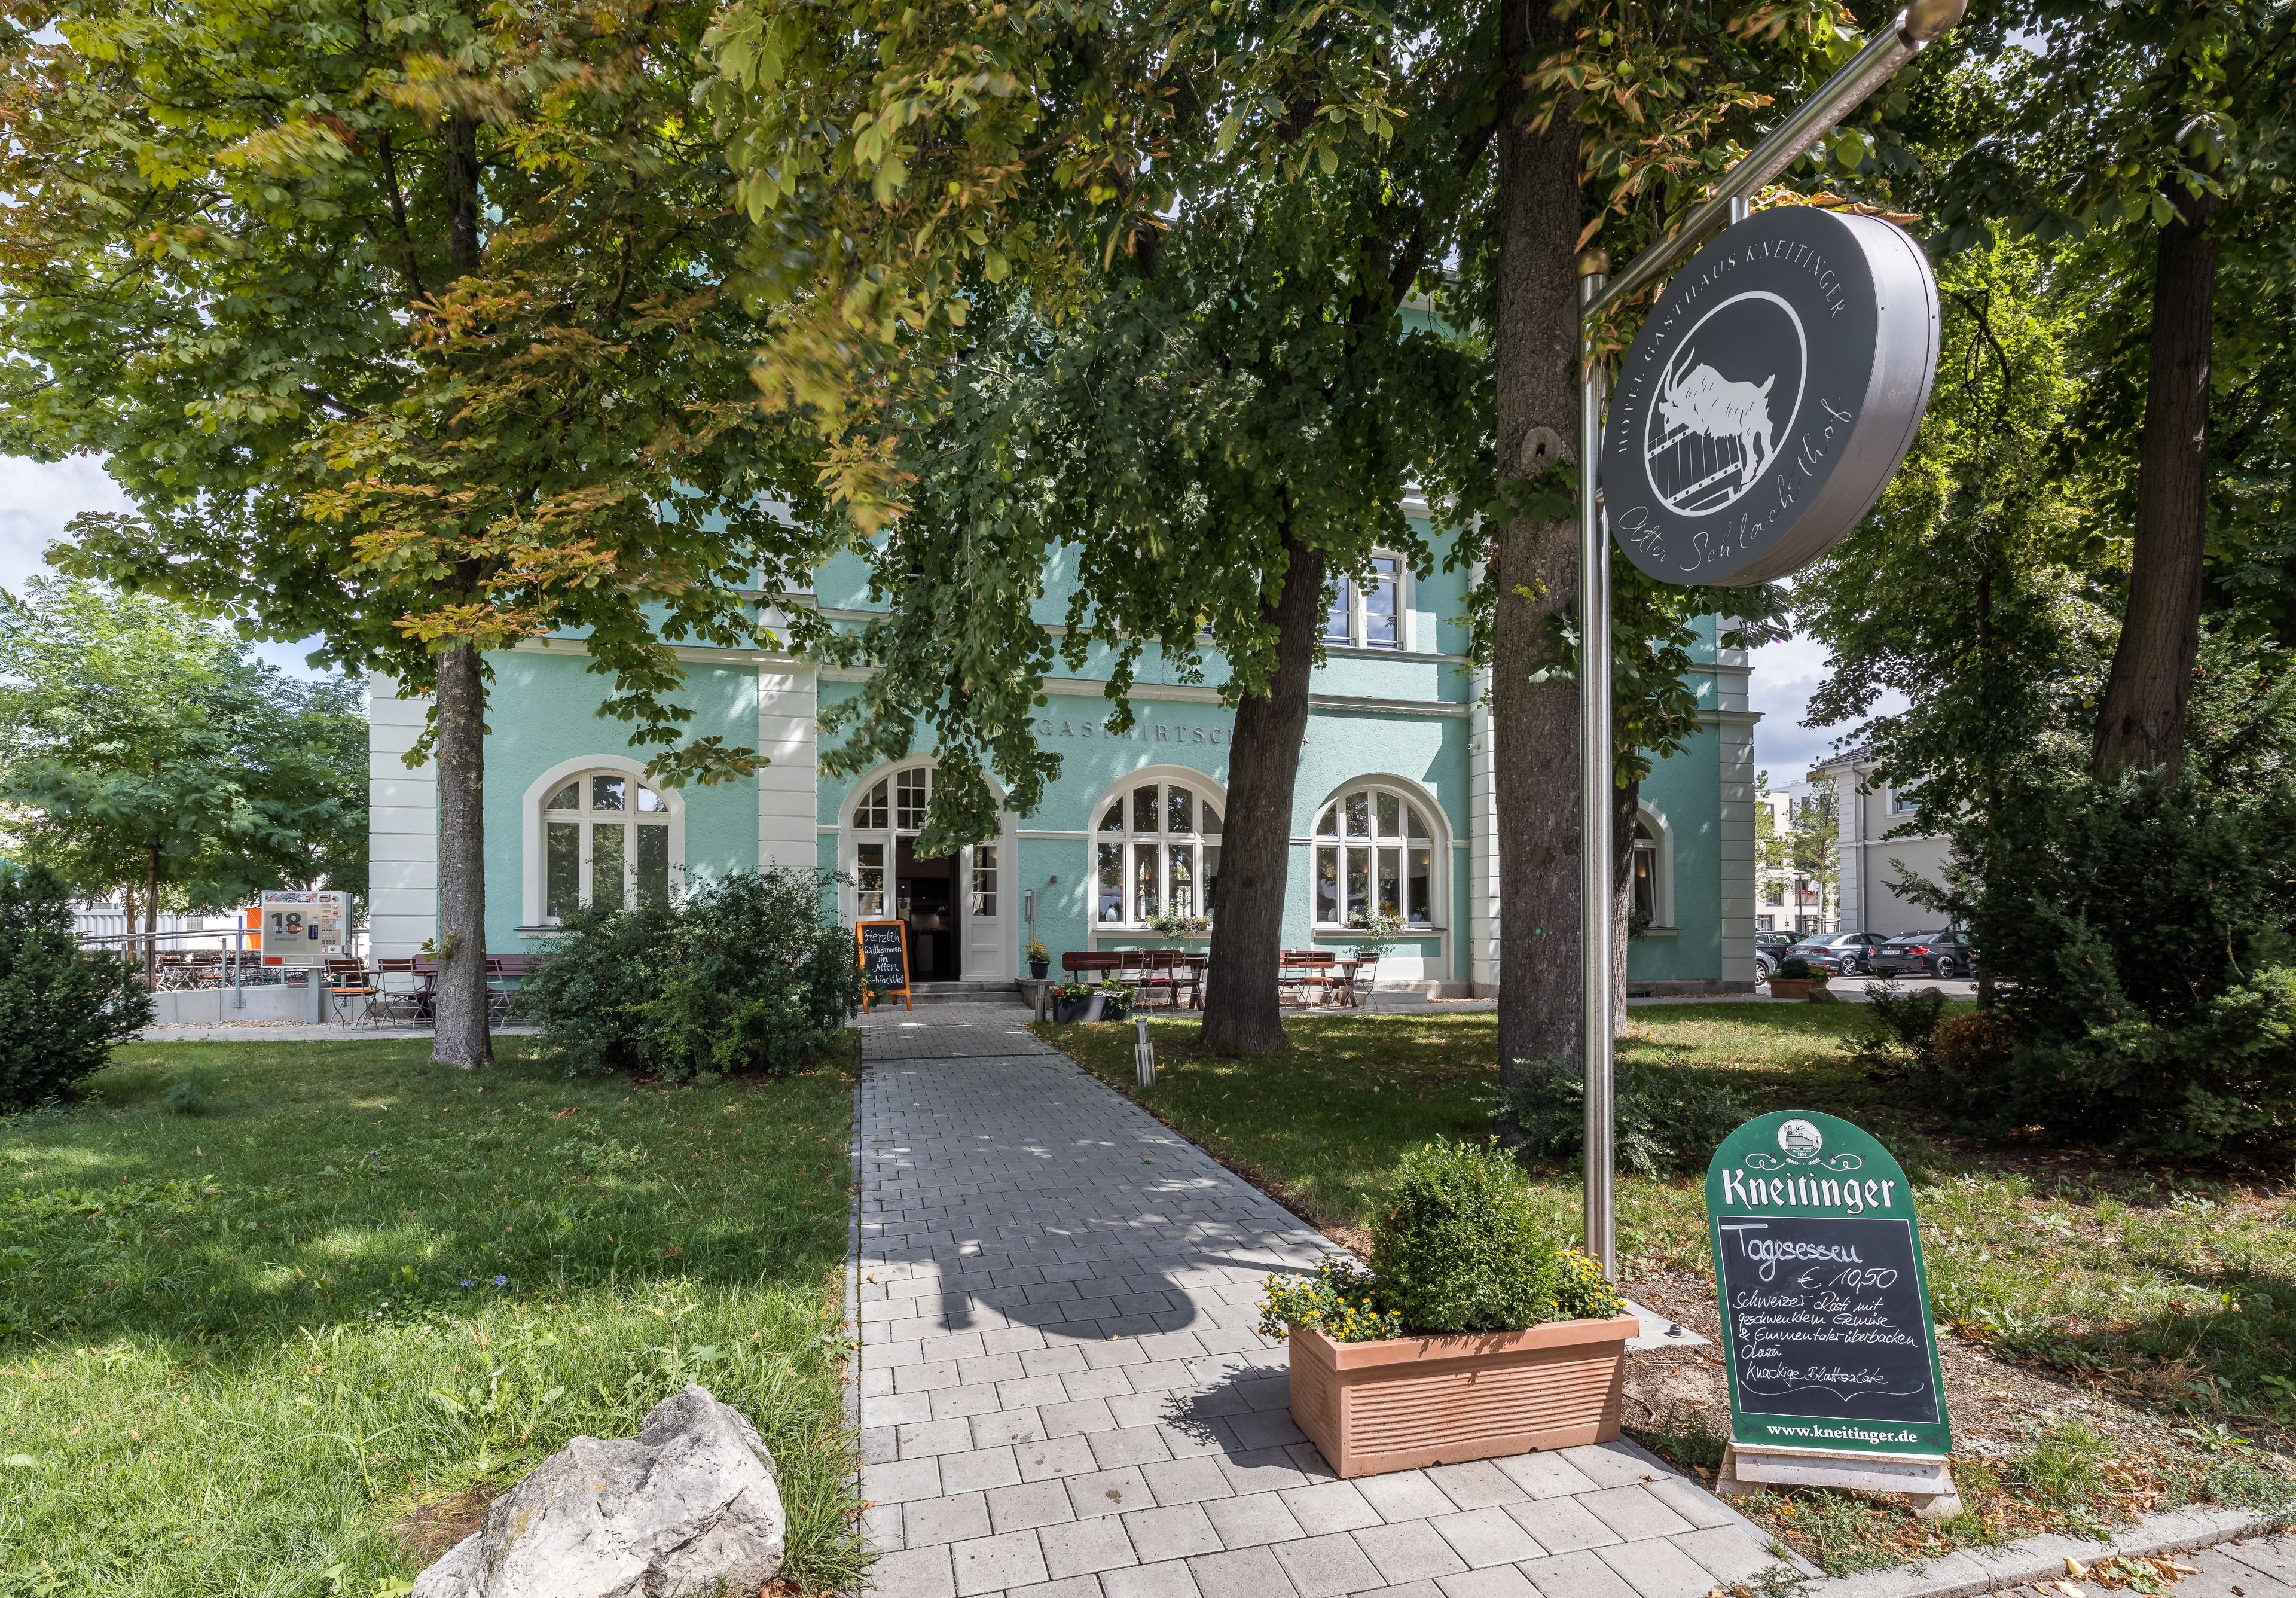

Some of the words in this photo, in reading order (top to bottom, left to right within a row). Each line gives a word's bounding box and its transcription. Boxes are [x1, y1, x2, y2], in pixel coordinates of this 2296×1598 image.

[1618, 373, 1644, 453] HOTEL
[1644, 252, 1736, 362] GASTHAUS
[1745, 240, 1846, 319] KNEITINGER
[271, 913, 301, 934] 18
[864, 944, 902, 954] Willkommen
[878, 954, 888, 963] im
[873, 963, 899, 972] Alten
[1721, 1168, 1896, 1215] Kneitinger
[1720, 1224, 1863, 1280] Tagesessen
[1797, 1268, 1822, 1289] €
[1829, 1267, 1897, 1294] 10,50
[1733, 1290, 1814, 1309] Schweizer
[1813, 1291, 1848, 1313] Rösti
[1853, 1297, 1885, 1313] mit
[1738, 1311, 1825, 1332] geschwenktem
[1833, 1311, 1897, 1328] Gemüse
[1739, 1328, 1750, 1341] &
[1754, 1327, 1845, 1342] Emmentaler
[1845, 1328, 1918, 1347] überbacken
[1767, 1425, 1918, 1444] www.kneitinger.de
